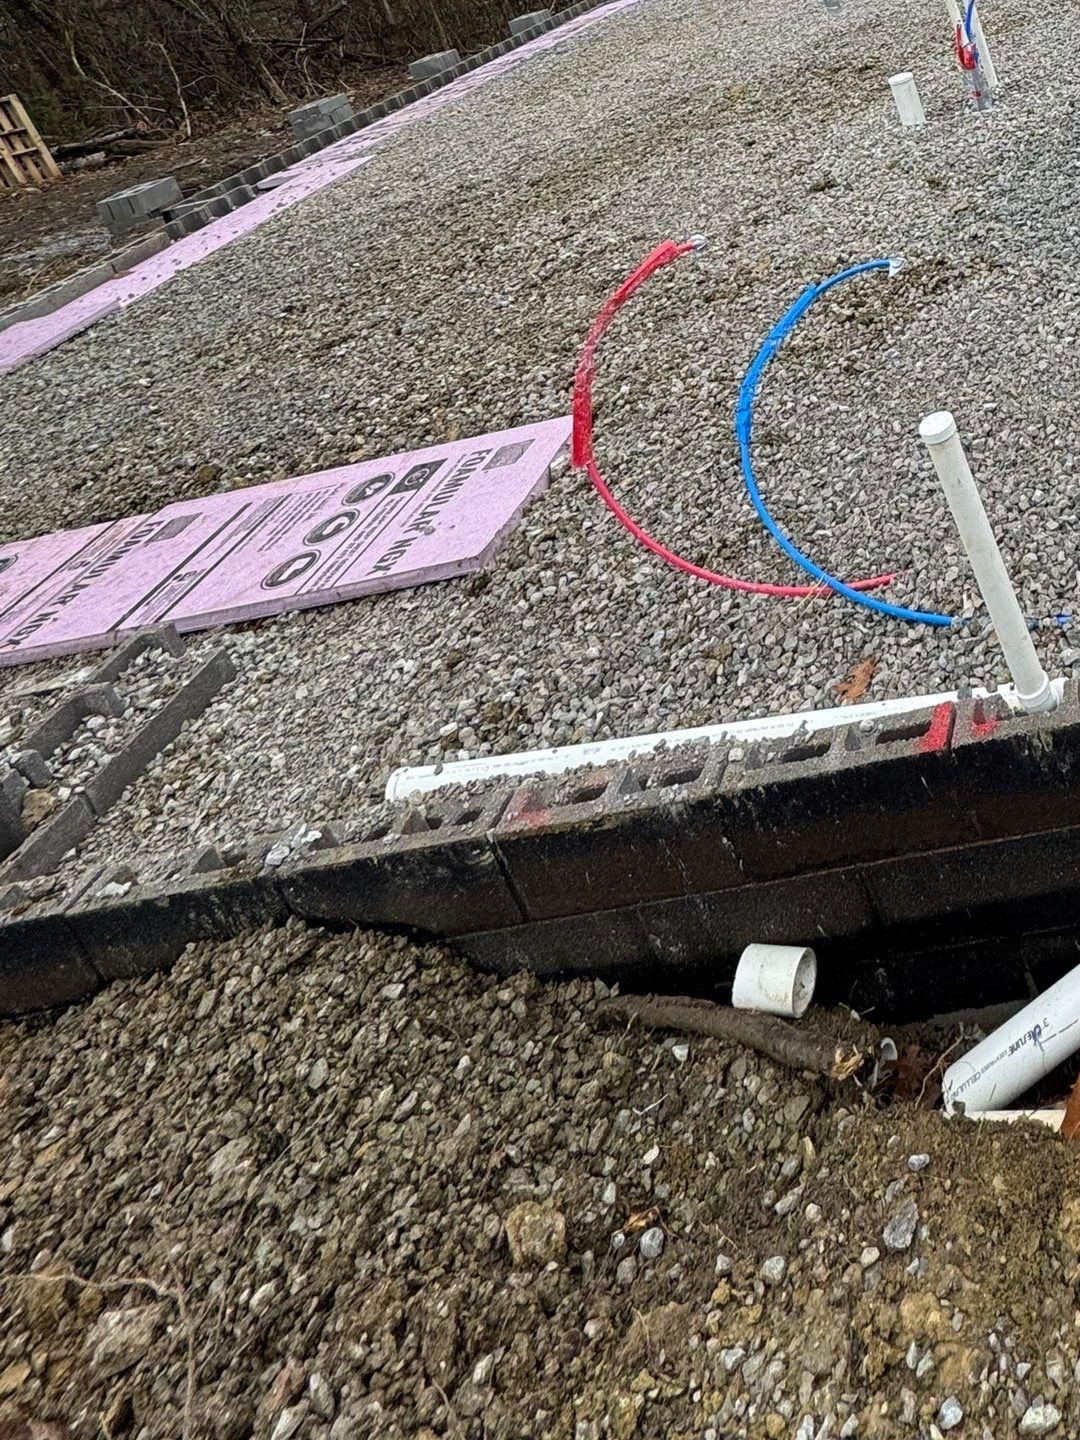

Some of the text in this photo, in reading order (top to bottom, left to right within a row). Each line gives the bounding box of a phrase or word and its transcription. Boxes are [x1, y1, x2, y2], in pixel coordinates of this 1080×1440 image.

[402, 448, 494, 534] FOAMULAR
[52, 520, 165, 606] FOAMULAR
[365, 536, 419, 576] NGX
